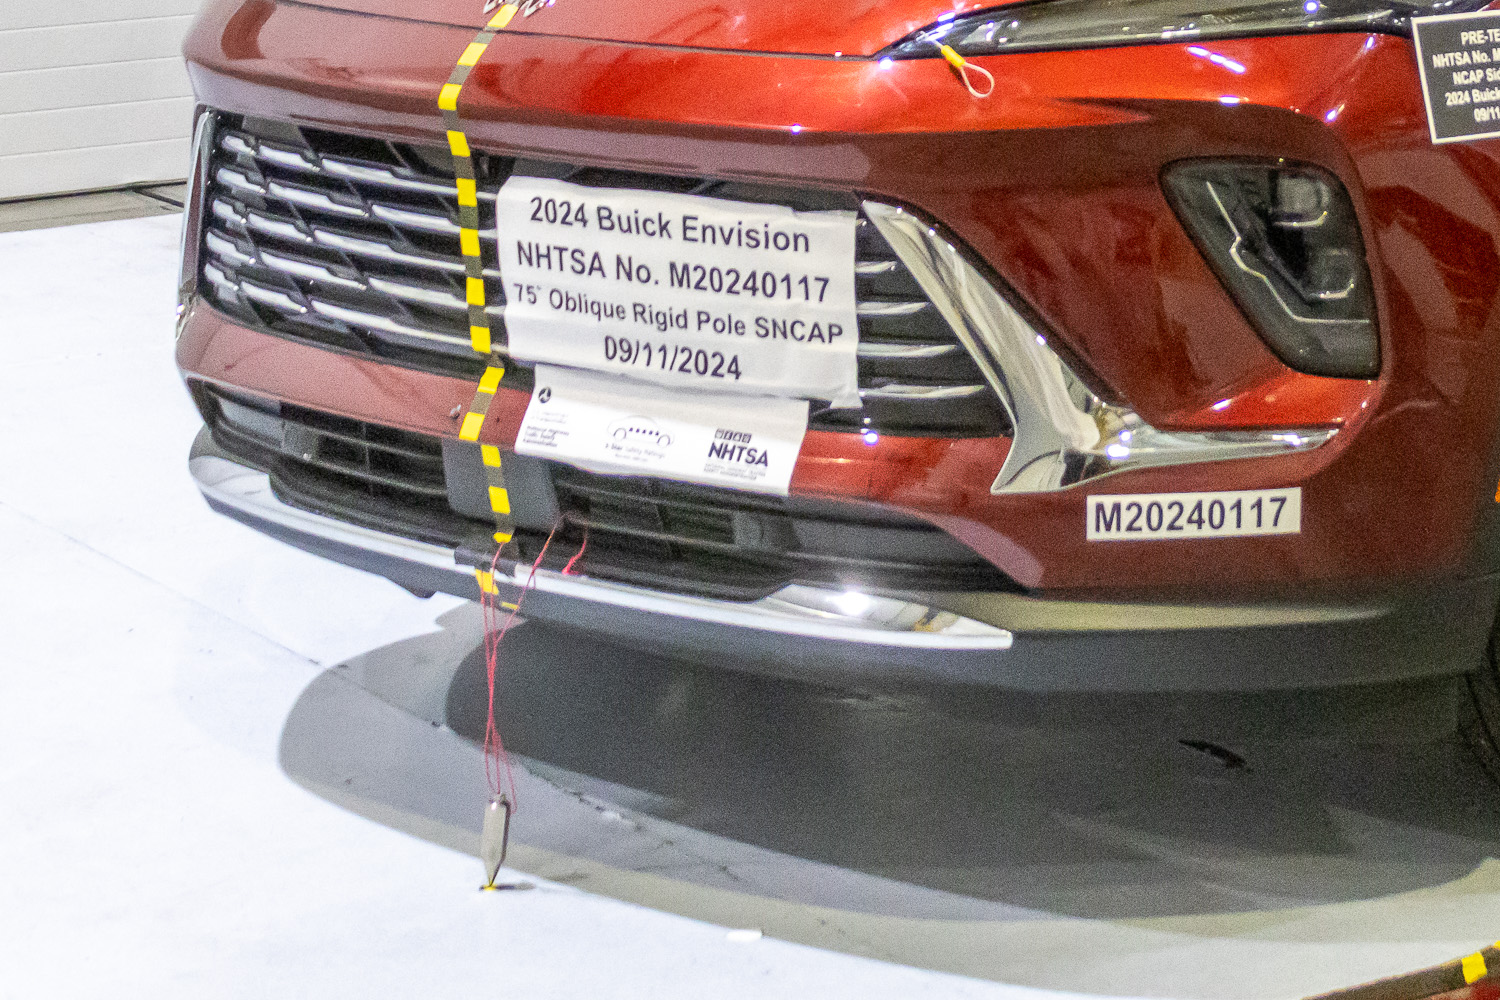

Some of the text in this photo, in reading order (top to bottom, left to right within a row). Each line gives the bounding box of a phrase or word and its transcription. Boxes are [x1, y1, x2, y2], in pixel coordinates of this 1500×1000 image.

[1432, 52, 1471, 68] NHTSA
[1472, 50, 1491, 64] No.
[1453, 70, 1484, 85] NCAP
[1445, 90, 1470, 106] 2024
[530, 197, 810, 252] 2024 Buick Envision
[517, 240, 830, 302] NHTSA No. M20240117
[549, 288, 626, 322] Oblique
[633, 302, 688, 332] Rigid
[697, 311, 746, 335] Pole
[755, 316, 843, 344] SNCAP
[604, 335, 742, 380] 09/11/2024
[708, 441, 768, 467] NHTSA
[1095, 496, 1287, 532] M20240117
